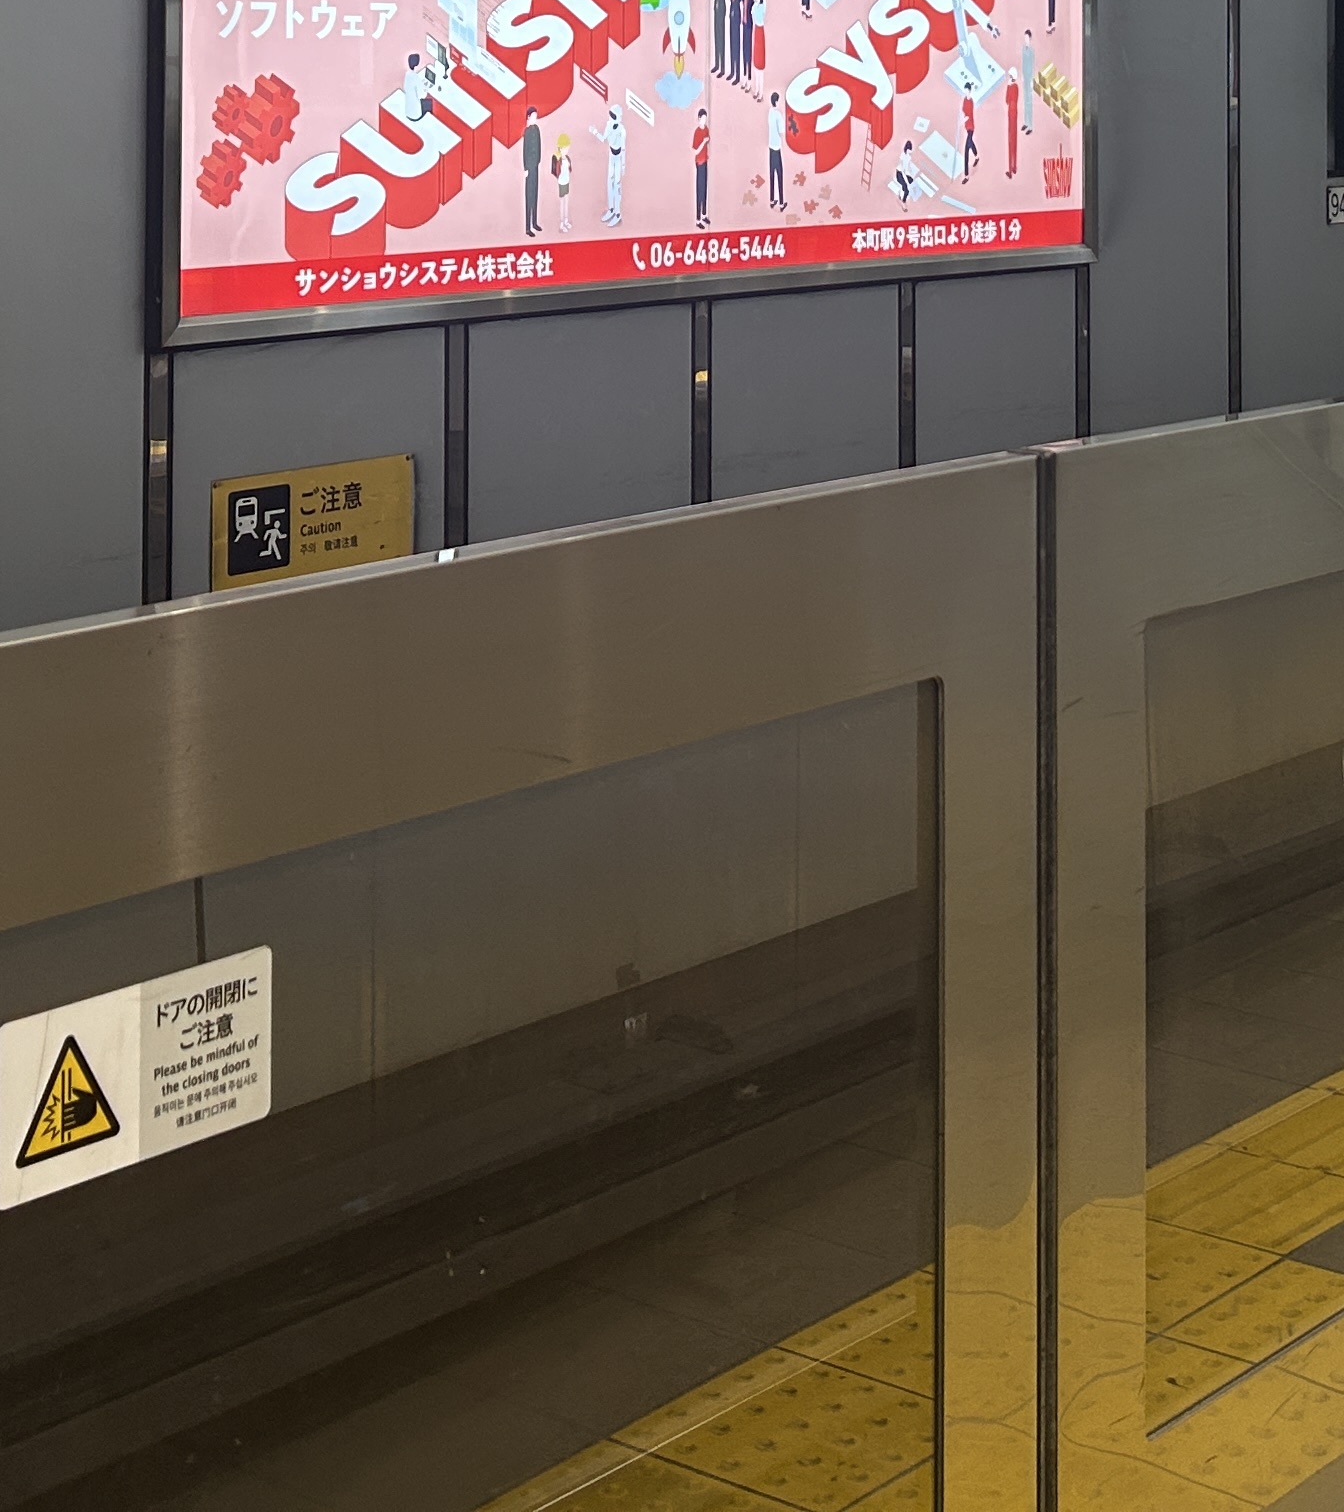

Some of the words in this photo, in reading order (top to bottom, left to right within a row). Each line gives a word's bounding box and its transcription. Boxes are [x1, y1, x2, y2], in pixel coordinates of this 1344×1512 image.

[650, 233, 786, 267] 06-6484-5444
[852, 218, 1022, 253] 本町駅9号出口より徒歩1分
[295, 250, 554, 297] サンショウシステム株式会社
[300, 481, 363, 515] ご注意
[300, 520, 342, 537] Caution
[156, 976, 258, 1028] ドアの開閉に
[180, 1013, 234, 1050] ご注意
[154, 1058, 187, 1080] Please
[190, 1052, 204, 1069] be
[206, 1039, 245, 1064] mindful
[248, 1033, 260, 1050] of
[161, 1081, 180, 1097] the
[182, 1067, 219, 1090] closing
[221, 1057, 251, 1076] doors
